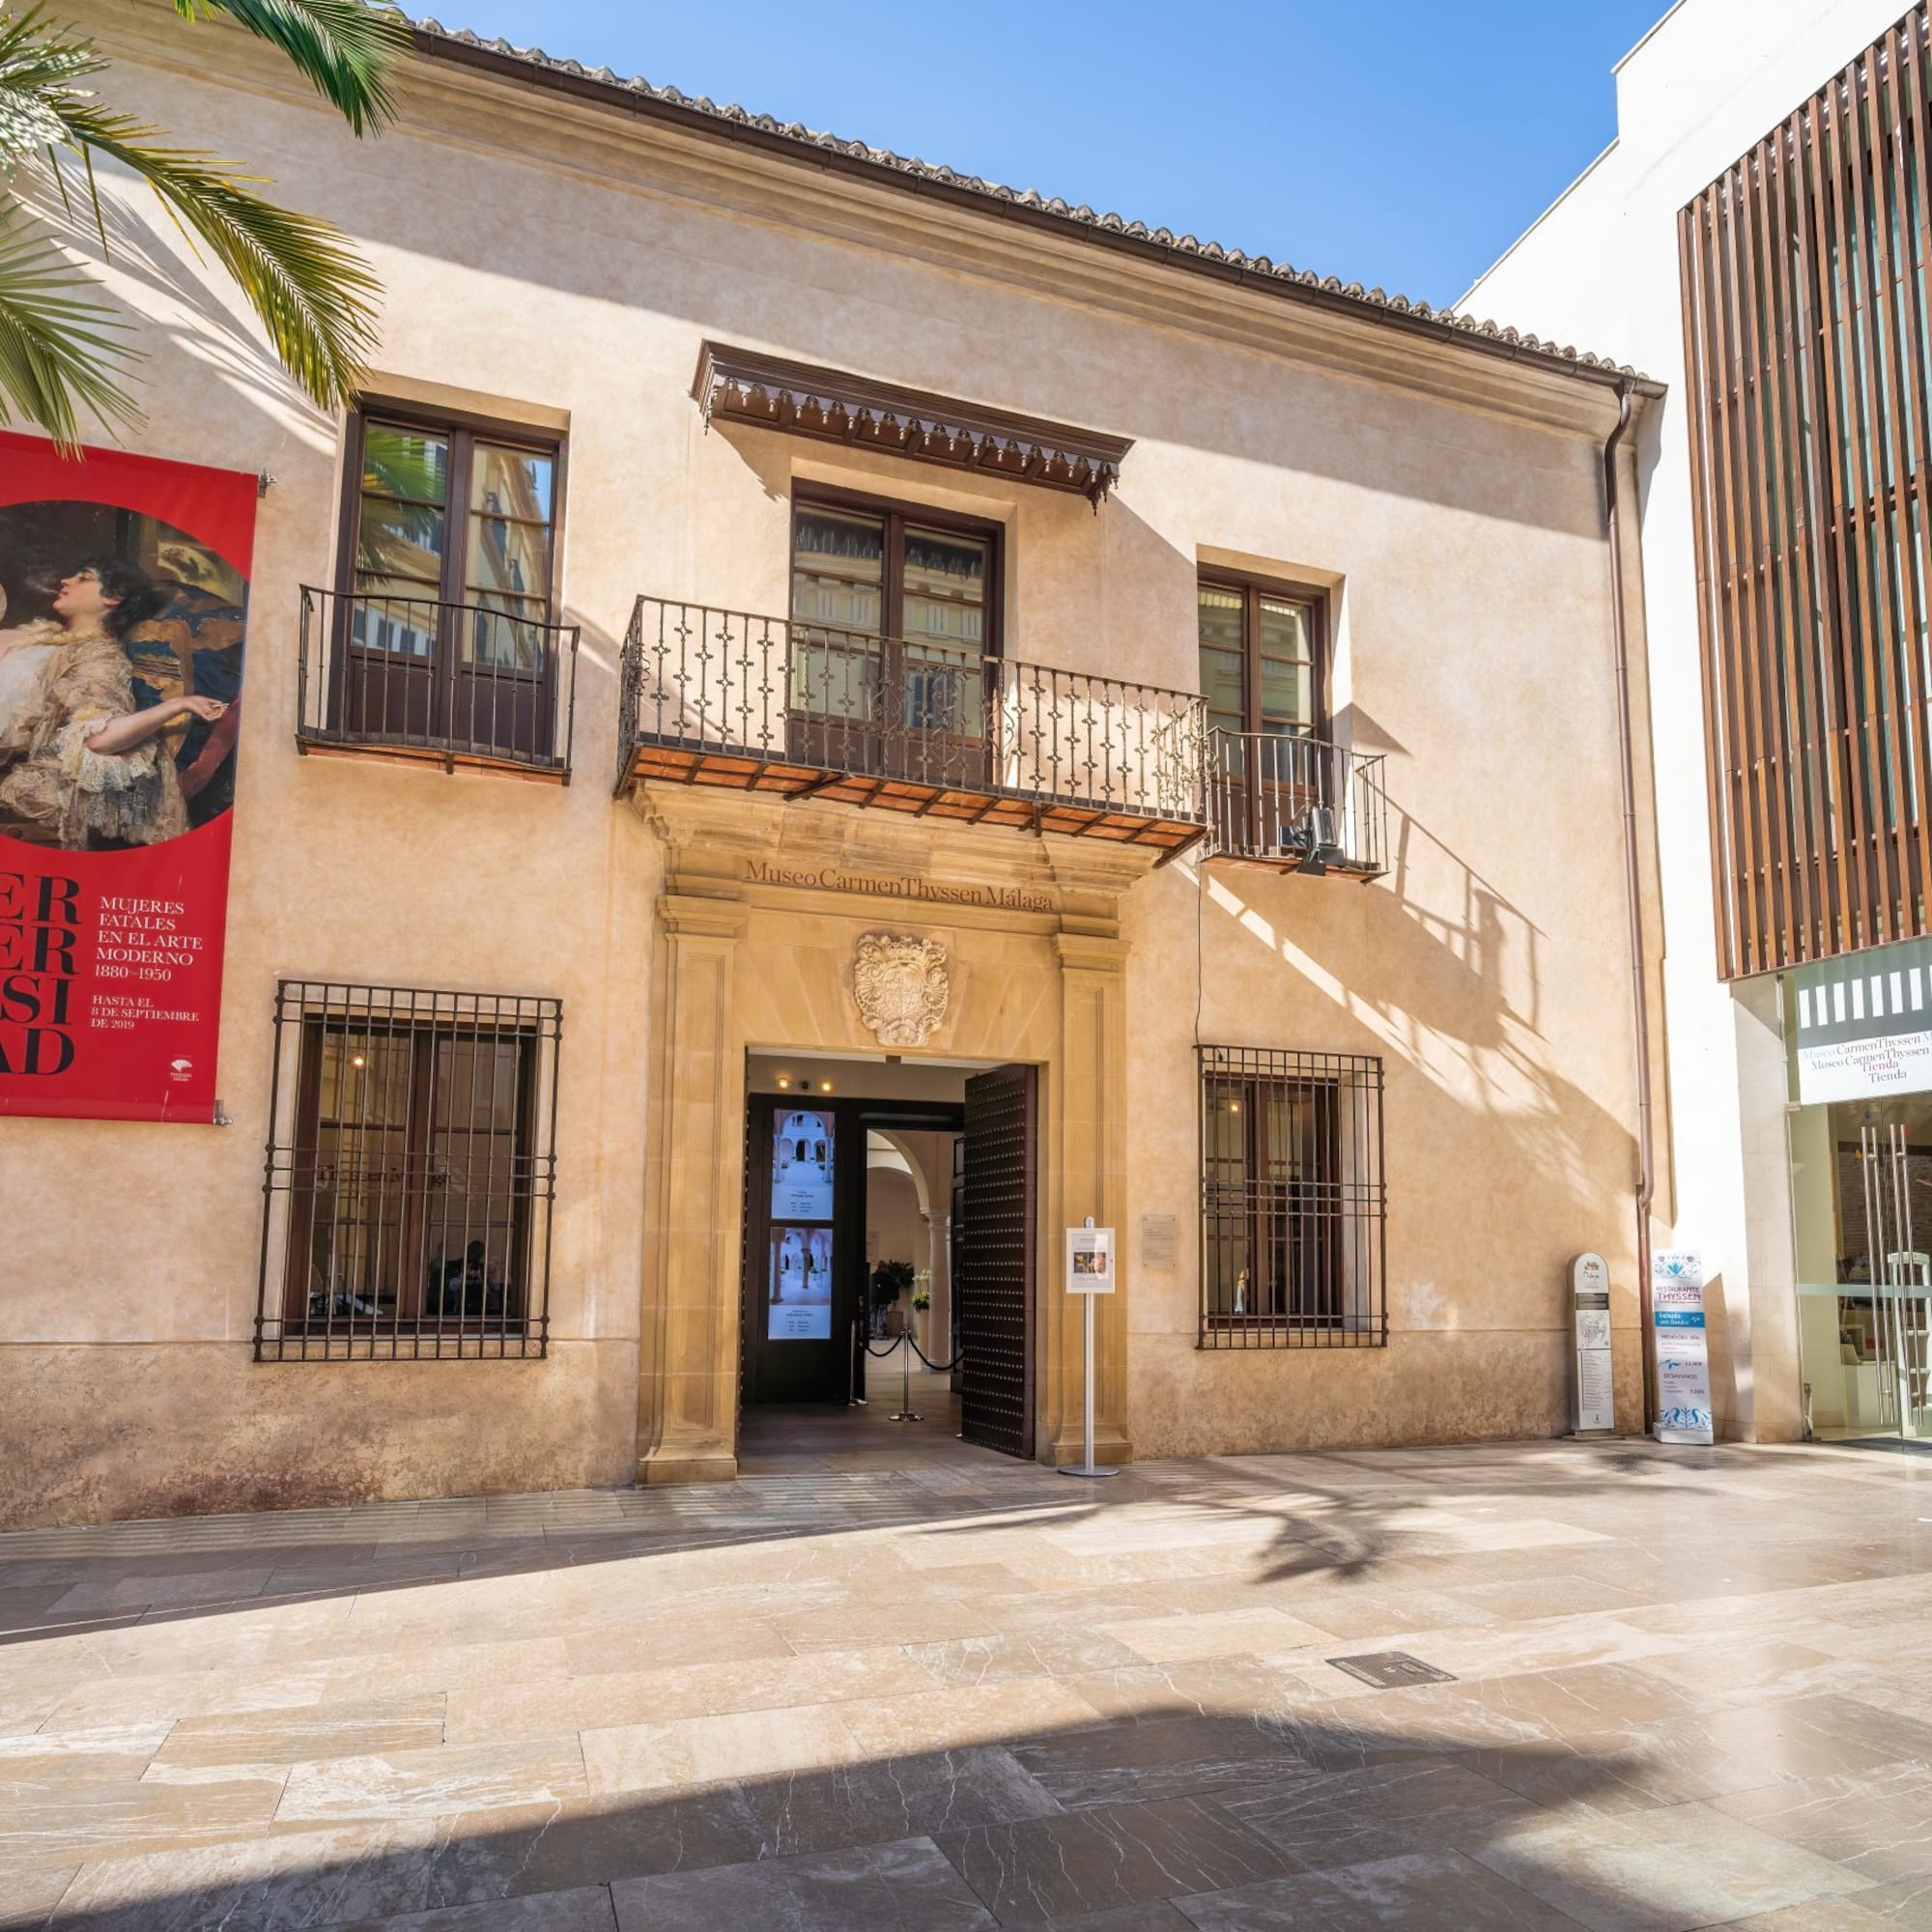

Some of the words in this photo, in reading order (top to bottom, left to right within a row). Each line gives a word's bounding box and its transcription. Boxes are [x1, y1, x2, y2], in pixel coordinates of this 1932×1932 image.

[745, 860, 817, 887] Museo
[985, 885, 1053, 913] Málaga
[100, 895, 185, 915] MUJERES
[99, 913, 177, 931] FATALES
[98, 930, 123, 944] EN
[128, 932, 151, 947] EL
[155, 935, 203, 951] ARTE
[97, 947, 193, 966] MODERNO
[93, 995, 135, 1008] HASTA
[137, 997, 155, 1008] EL
[91, 1007, 99, 1016] 8
[100, 1008, 119, 1018] DE
[121, 1009, 200, 1022] SEPTIEMBRE
[90, 1019, 109, 1029] DE
[110, 1020, 135, 1030] 2019
[1868, 1069, 1907, 1083] Tienda
[1658, 1292, 1701, 1300] THYSSEN
